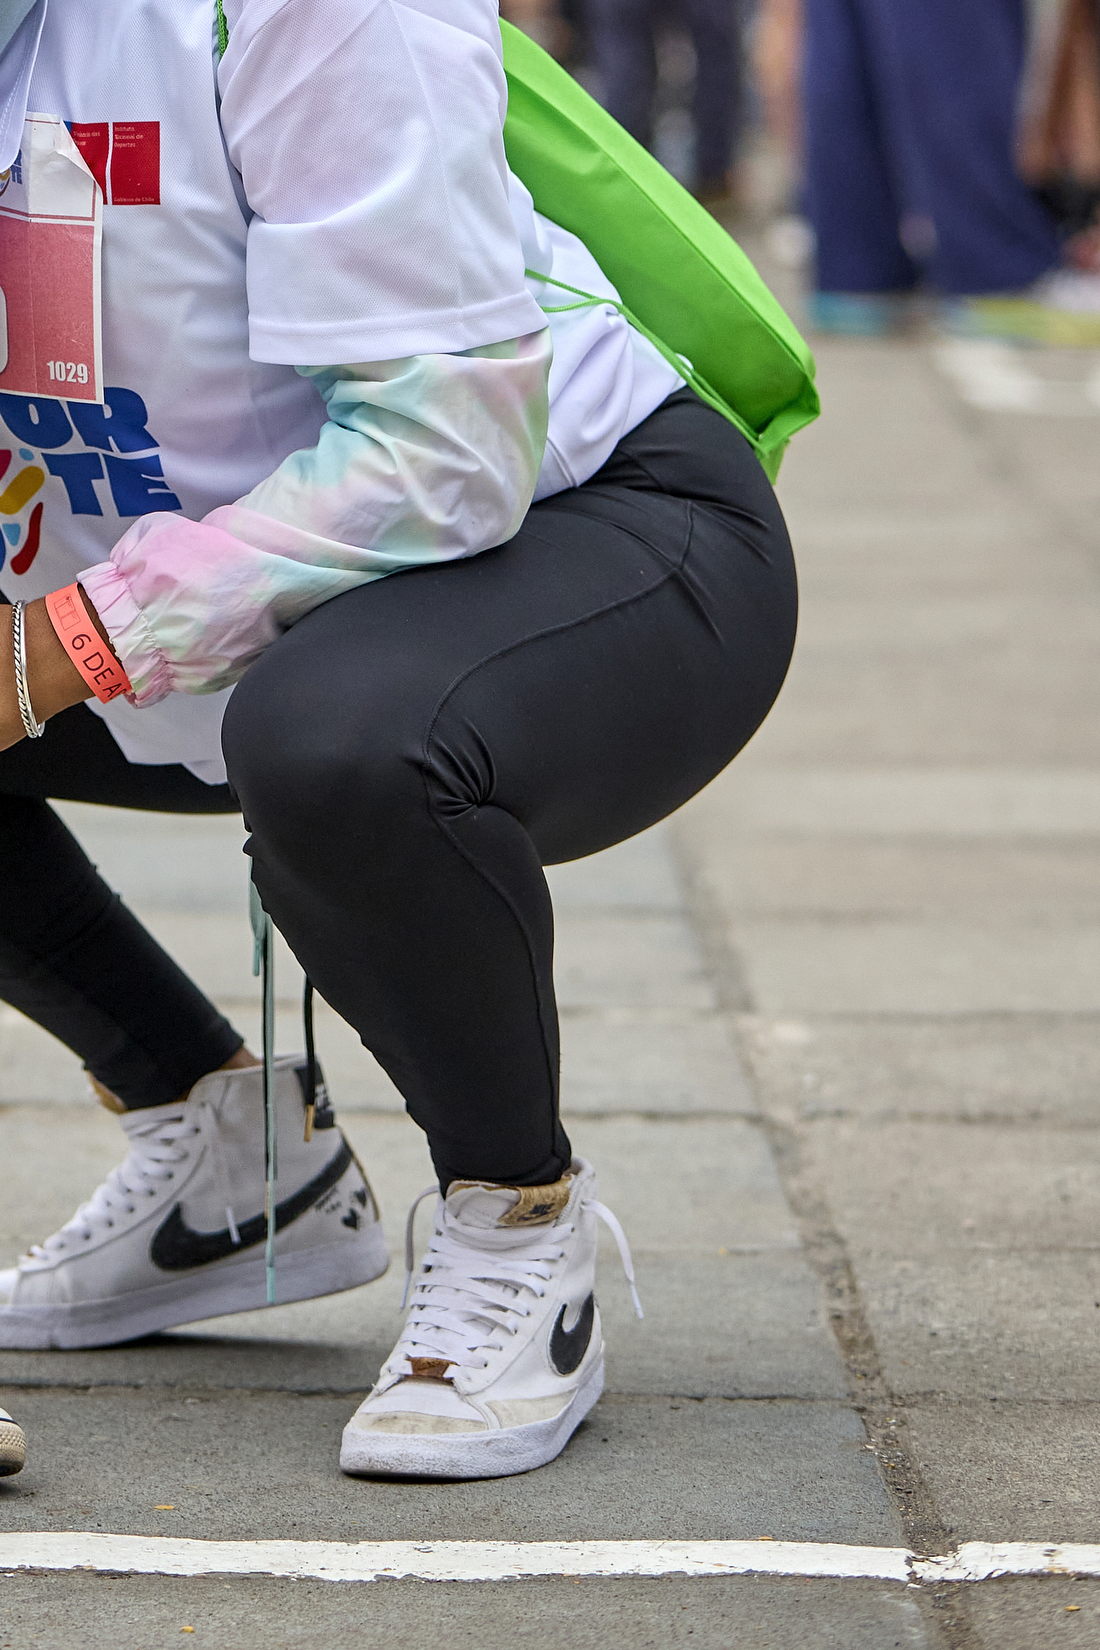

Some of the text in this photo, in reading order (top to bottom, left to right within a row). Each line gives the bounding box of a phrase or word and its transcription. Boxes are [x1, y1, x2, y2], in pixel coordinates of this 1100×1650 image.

[46, 360, 89, 384] 1029
[41, 452, 183, 517] TE
[71, 633, 92, 651] 6
[82, 651, 115, 686] DE
